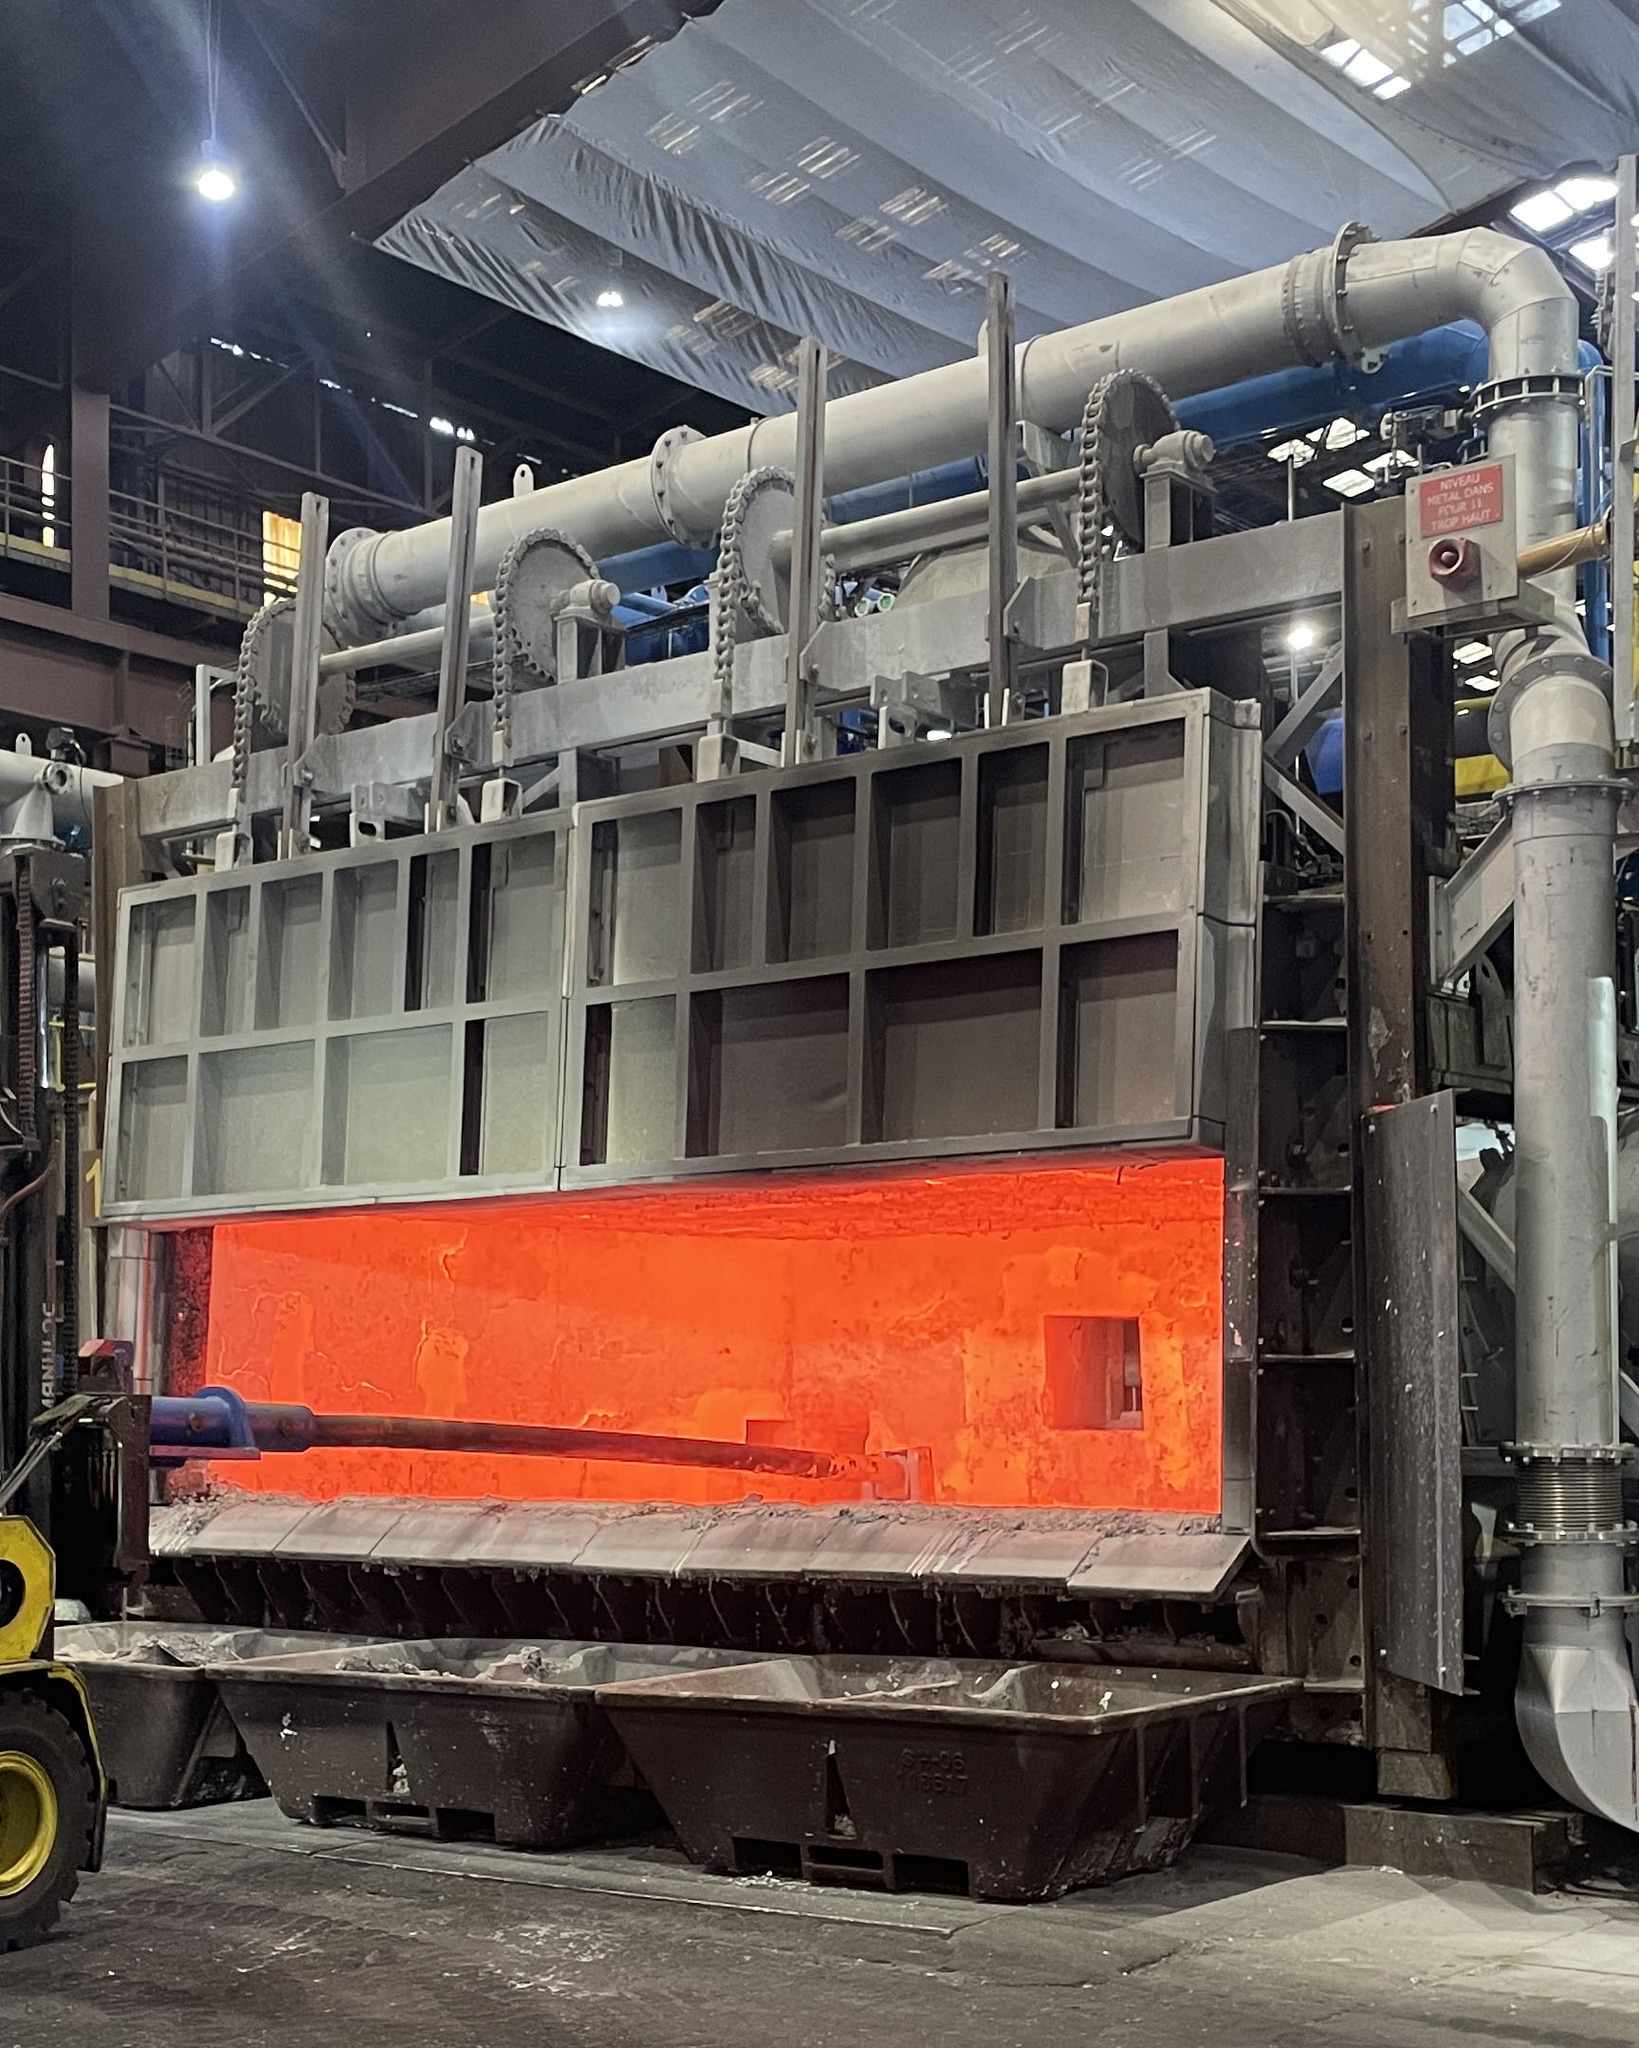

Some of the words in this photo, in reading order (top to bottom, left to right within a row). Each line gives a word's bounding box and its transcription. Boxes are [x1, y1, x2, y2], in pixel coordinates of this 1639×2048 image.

[1440, 472, 1481, 491] NIVEAU
[1427, 491, 1461, 507] METAL
[1464, 482, 1494, 499] DANS
[1431, 516, 1459, 532] TROP
[1461, 508, 1491, 525] HAUT
[1438, 502, 1467, 517] FOUR
